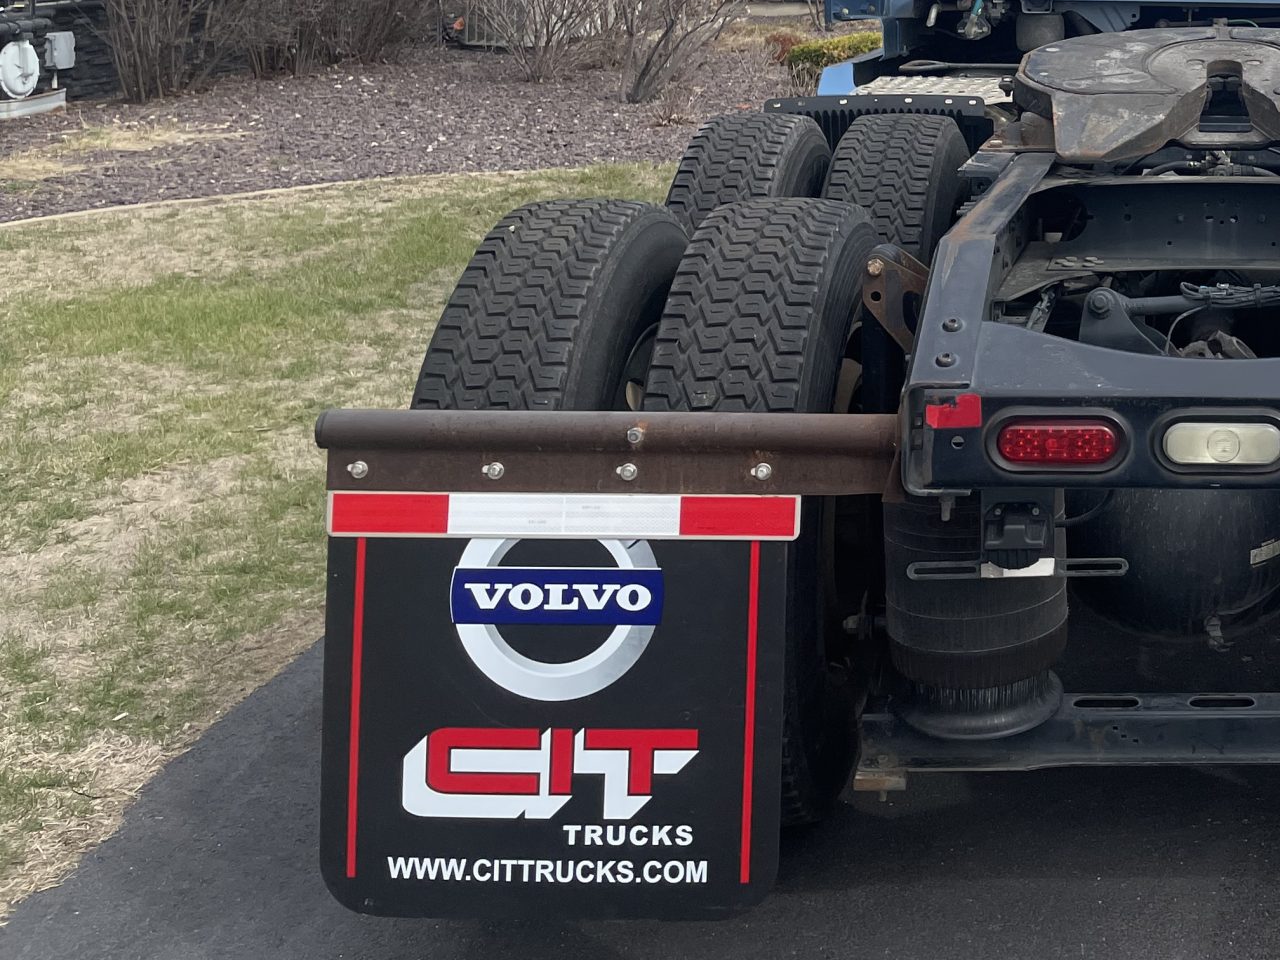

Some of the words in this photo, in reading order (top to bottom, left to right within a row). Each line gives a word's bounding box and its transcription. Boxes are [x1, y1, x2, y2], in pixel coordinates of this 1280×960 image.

[464, 582, 652, 612] VOLVO
[401, 726, 700, 820] CIT
[562, 824, 694, 847] TRUCKS
[387, 855, 709, 885] WWW.CITTRUCKS.COM
